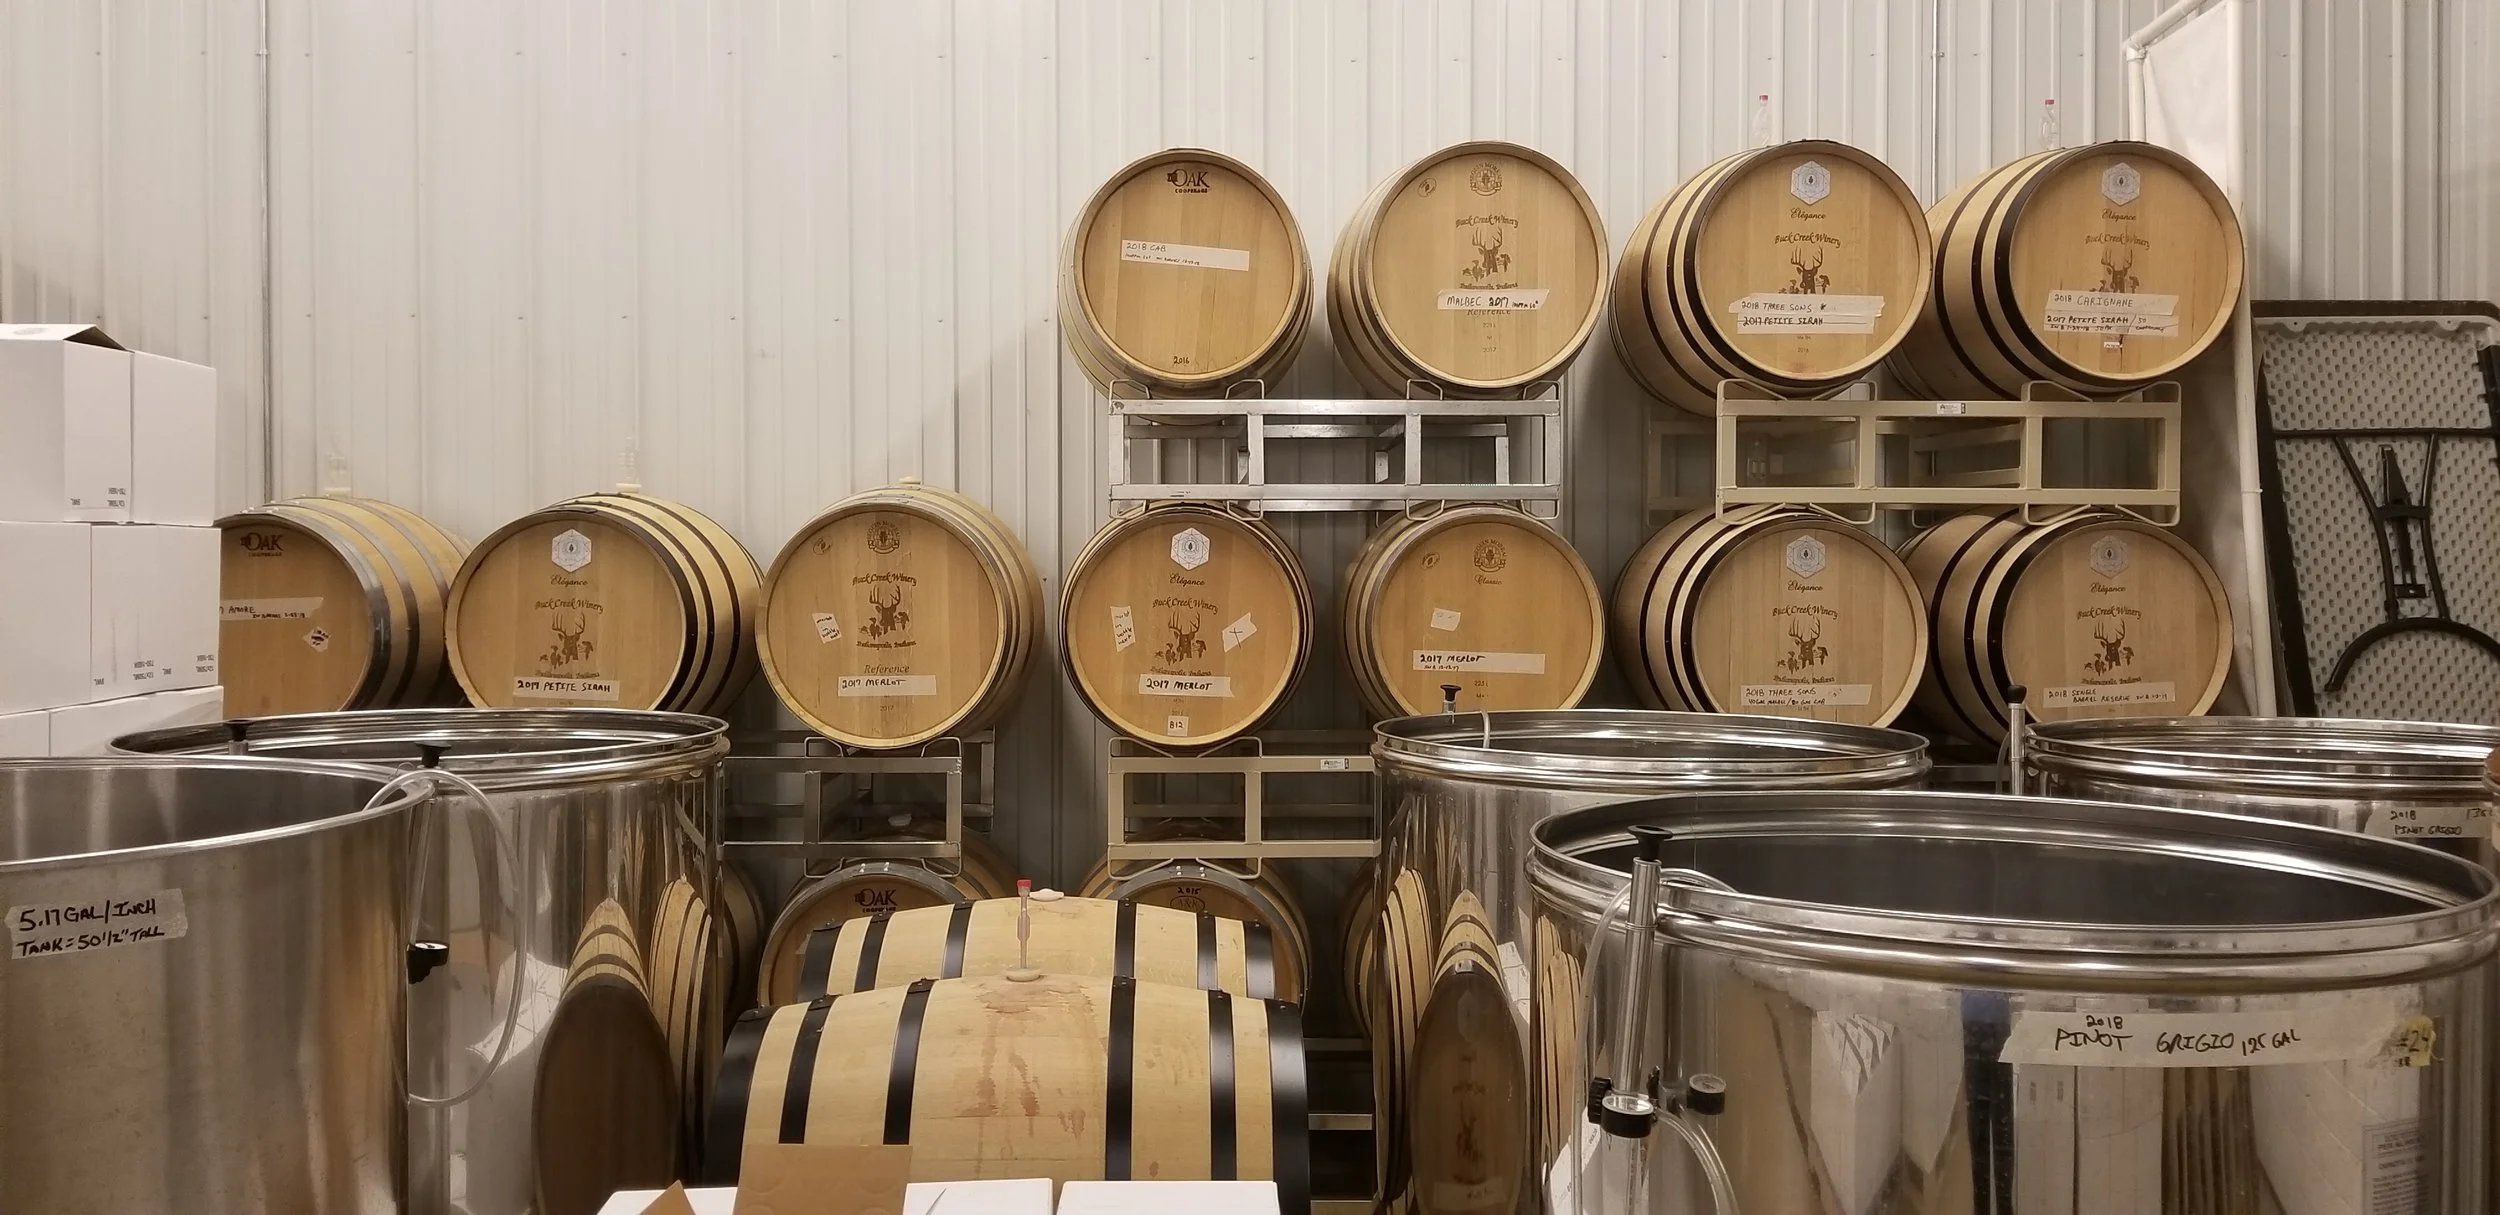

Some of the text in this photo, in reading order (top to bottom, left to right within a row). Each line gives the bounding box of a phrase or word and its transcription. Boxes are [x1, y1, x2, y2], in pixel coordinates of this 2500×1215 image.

[1172, 169, 1210, 188] OAK
[1775, 232, 1841, 249] Buck Creek Winery
[1126, 242, 1166, 253] 2018 CAB
[1446, 295, 1482, 307] MALBEC
[1488, 296, 1509, 308] 2017
[1741, 301, 1812, 313] 2018 THREE SONS
[2054, 294, 2133, 308] 2018 CARIGNANE
[1763, 317, 1793, 325] PETITE
[1798, 317, 1824, 326] SIRAH
[2047, 314, 2066, 322] 2017
[2068, 315, 2097, 324] PETITE
[2100, 316, 2129, 324] SIRAH
[1173, 355, 1190, 365] 2016
[245, 532, 284, 552] OAK
[871, 572, 892, 584] Creek
[892, 572, 918, 587] Winery
[554, 598, 577, 610] Creek
[577, 599, 604, 615] Winery
[1152, 596, 1219, 615] Buck Creek Winery
[1772, 604, 1839, 620] Buck Creek Winery
[2096, 605, 2117, 618] Creek
[2116, 605, 2142, 621] Winery
[1420, 654, 1487, 664] 2017 MERLOT
[864, 664, 910, 676] Reference
[517, 680, 611, 693] 2017 PETITE SIRAH
[842, 679, 907, 689] 2017 MERLOT
[1146, 678, 1214, 691] 2017 MERLOT
[1745, 688, 1765, 697] 2018
[2048, 688, 2097, 698] 2018 SINGLE
[1169, 720, 1184, 729] B12
[2390, 809, 2417, 821] 2018
[2394, 824, 2463, 836] PINOT GRIGIO
[859, 888, 898, 907] OAK
[18, 908, 61, 932] 5.17
[130, 926, 165, 942] TALL
[2086, 1015, 2123, 1030] 2018
[2055, 1028, 2301, 1057] PINOT GRIGIO 125 GAL
